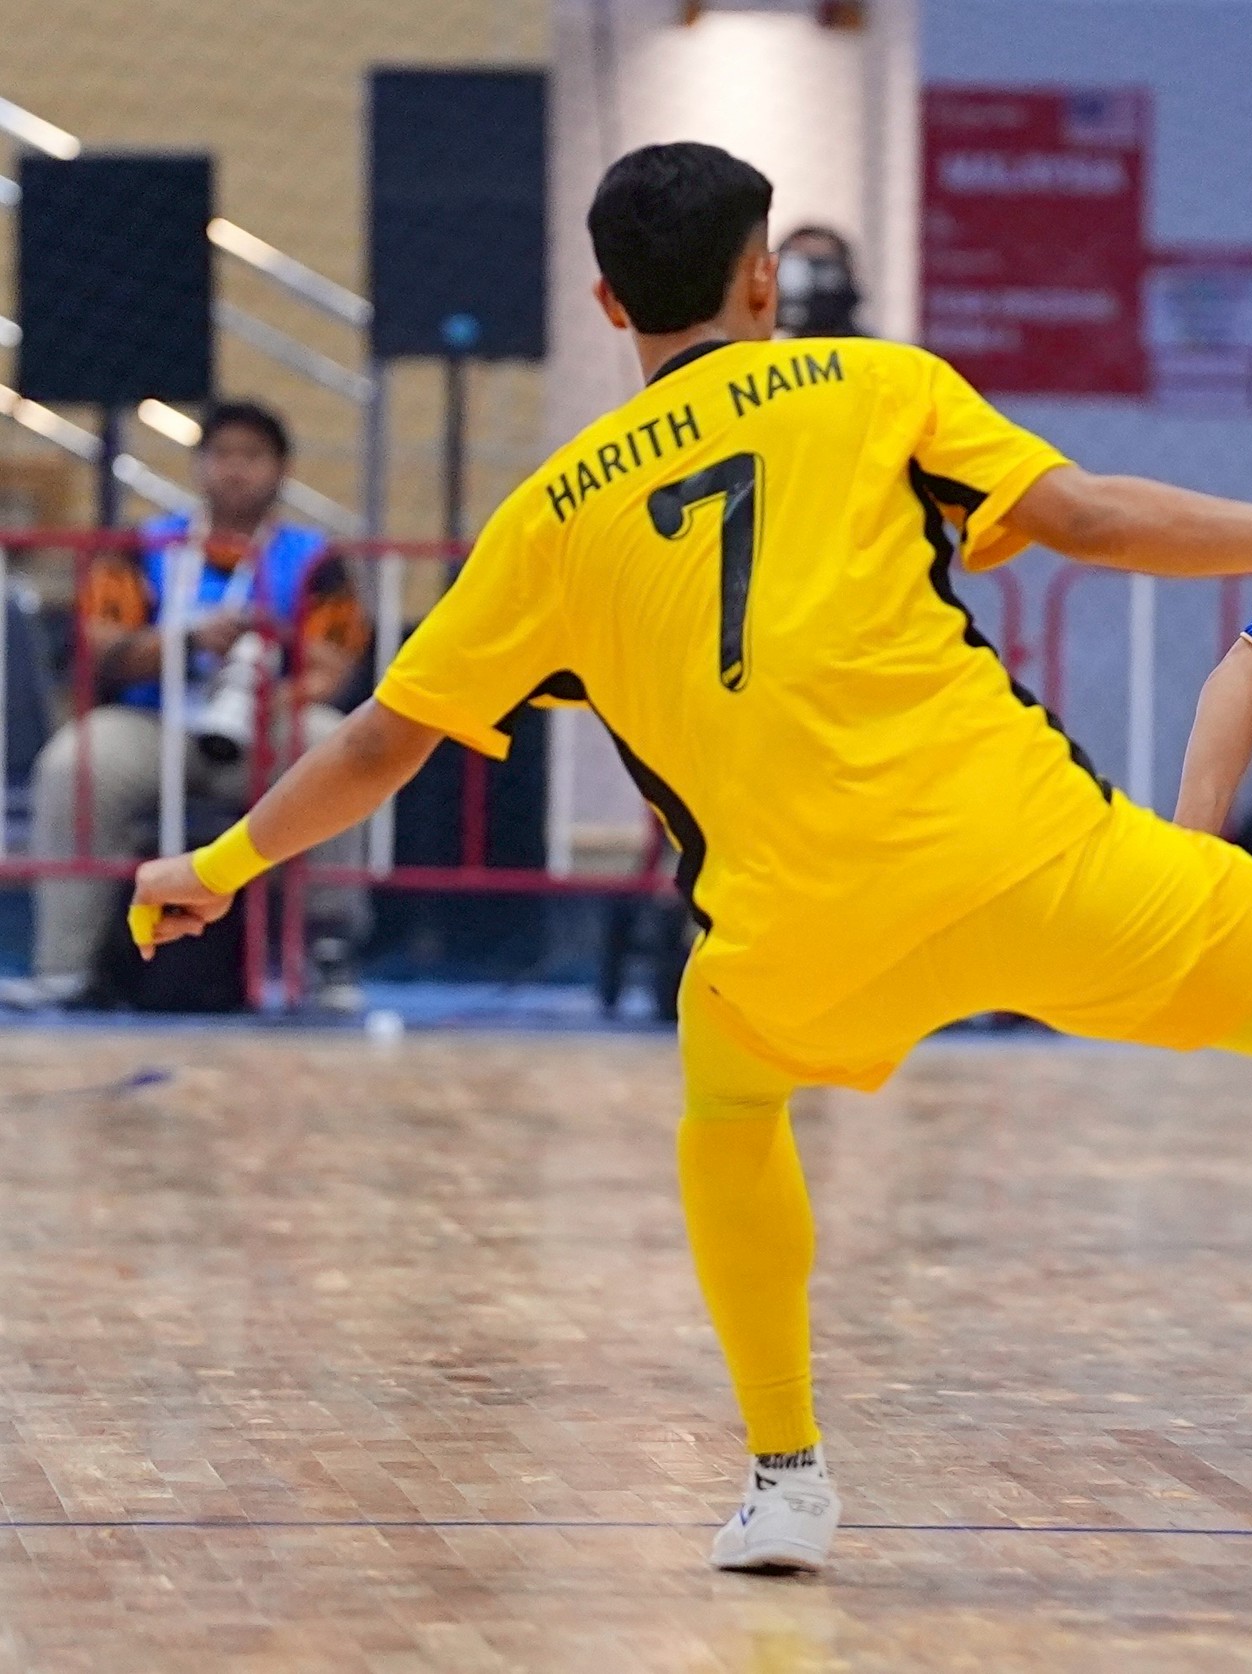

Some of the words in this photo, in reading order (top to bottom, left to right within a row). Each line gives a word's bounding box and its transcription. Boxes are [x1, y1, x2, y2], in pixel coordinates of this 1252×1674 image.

[546, 404, 701, 523] HARITH
[728, 350, 844, 418] NAIM
[647, 450, 764, 693] 7
